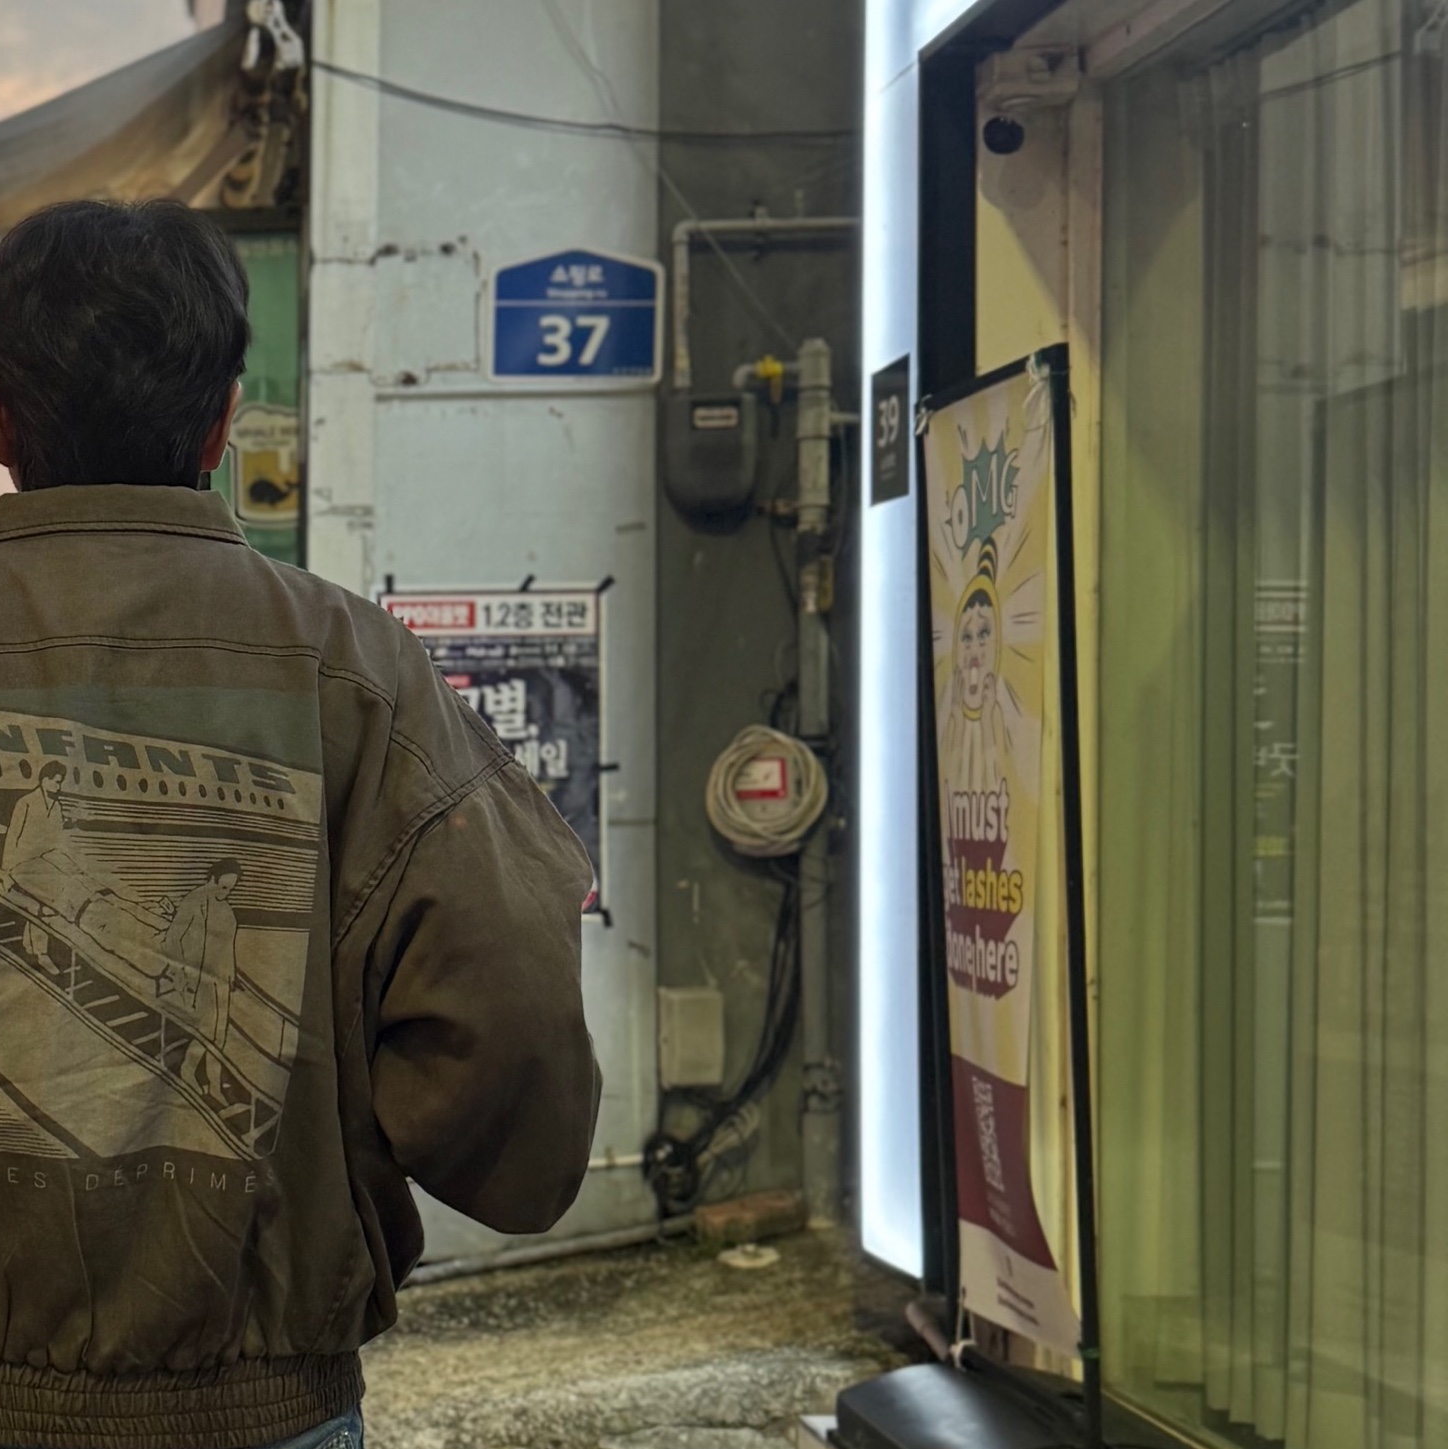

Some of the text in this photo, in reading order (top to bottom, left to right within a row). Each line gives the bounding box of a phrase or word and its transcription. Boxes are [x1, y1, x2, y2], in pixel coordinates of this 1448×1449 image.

[536, 314, 611, 366] 37
[877, 394, 900, 448] 39
[951, 447, 1020, 551] OMG
[541, 601, 588, 629] 전관
[952, 777, 1010, 843] must
[961, 855, 1024, 914] lashes
[975, 923, 1020, 988] here
